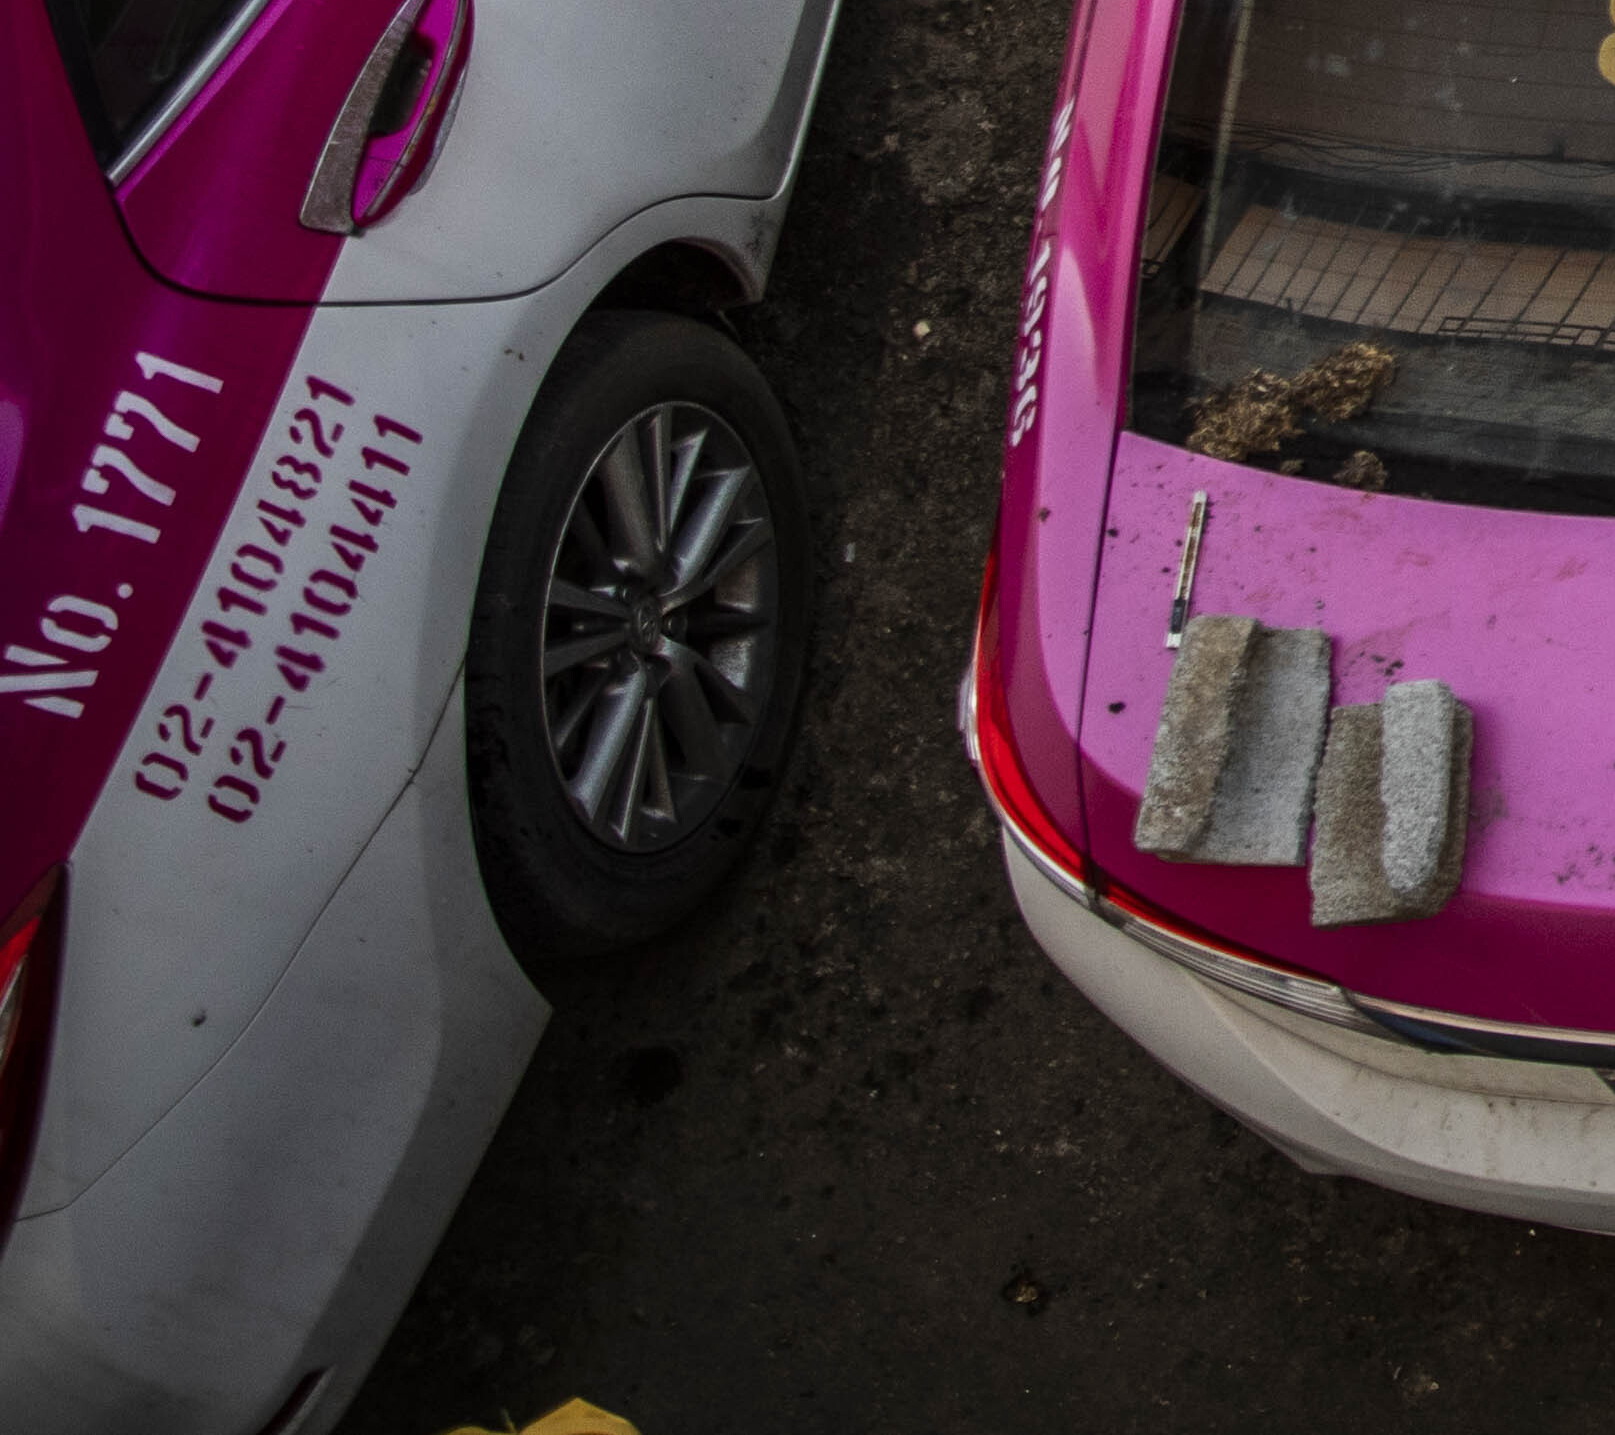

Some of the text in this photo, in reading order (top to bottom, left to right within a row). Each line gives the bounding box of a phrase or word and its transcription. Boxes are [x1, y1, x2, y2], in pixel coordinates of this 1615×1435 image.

[0, 350, 224, 720] No. 1771
[134, 375, 356, 802] 02-4104821
[207, 413, 424, 824] 02-4104411
